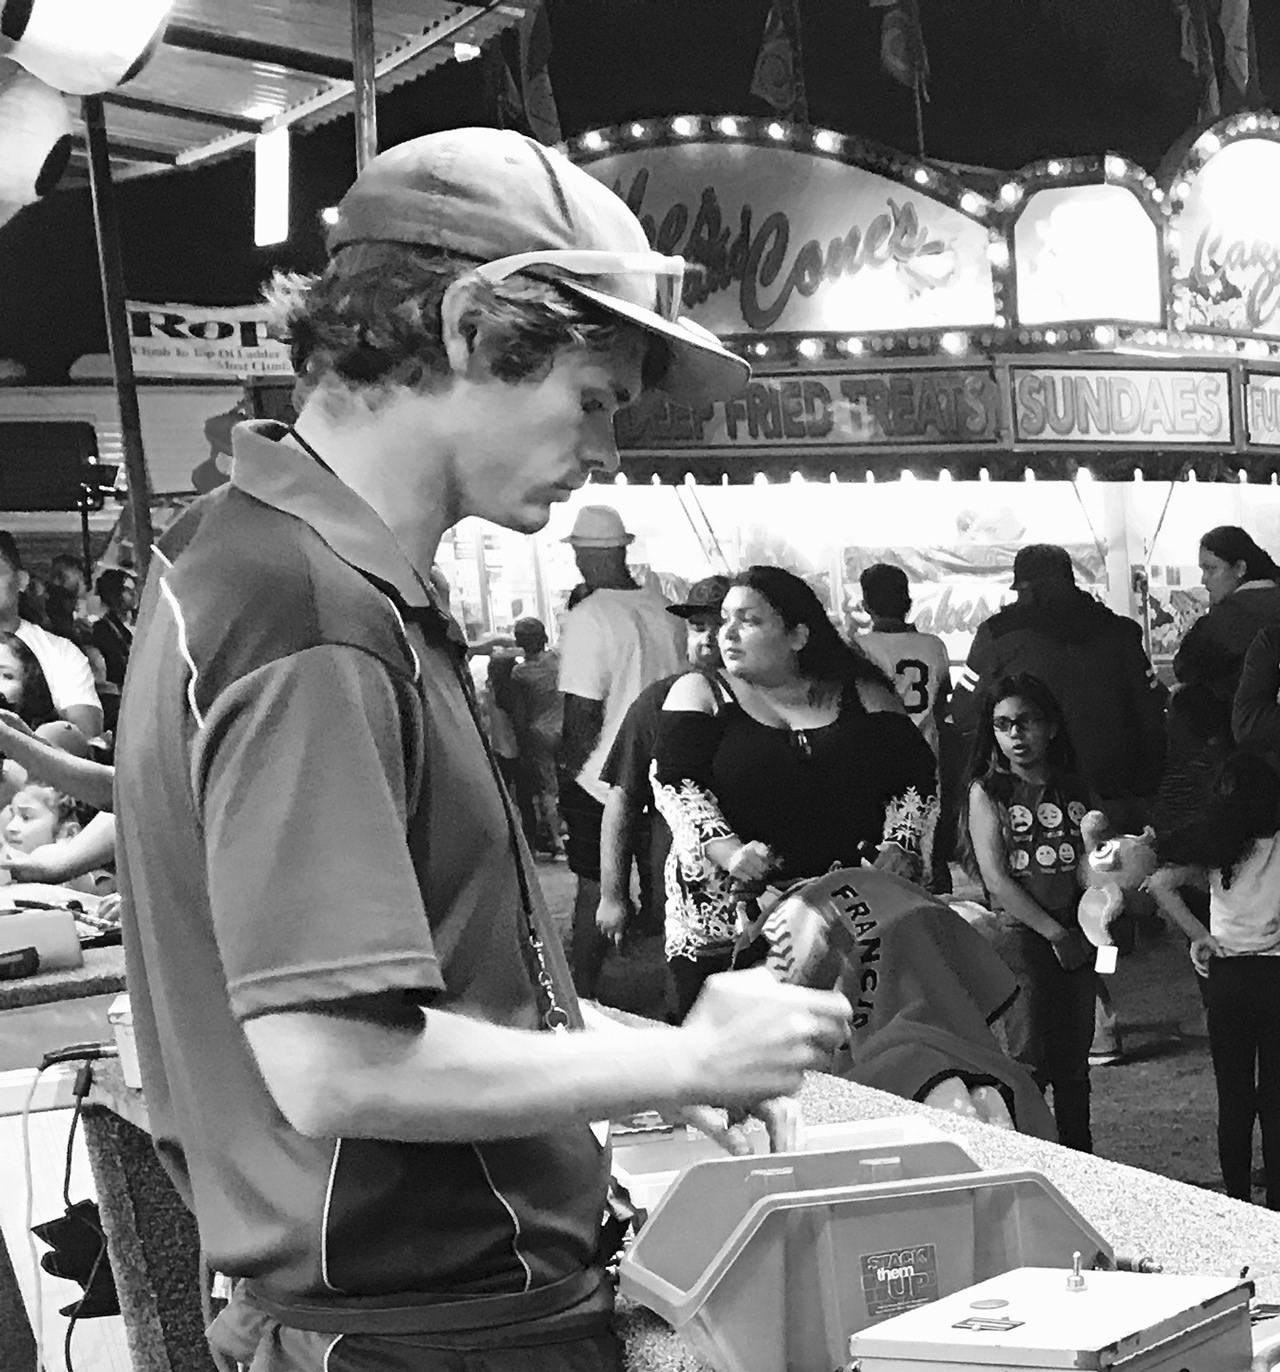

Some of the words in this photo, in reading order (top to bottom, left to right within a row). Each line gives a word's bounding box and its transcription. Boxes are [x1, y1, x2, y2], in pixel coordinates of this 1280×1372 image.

[740, 198, 928, 330] Cones
[724, 381, 833, 441] FRIED
[840, 375, 988, 437] TREATS
[1018, 374, 1223, 437] SUNDAES
[895, 658, 929, 714] 3
[867, 1247, 928, 1271] STACK
[876, 1265, 915, 1282] them
[887, 1271, 929, 1300] UP
